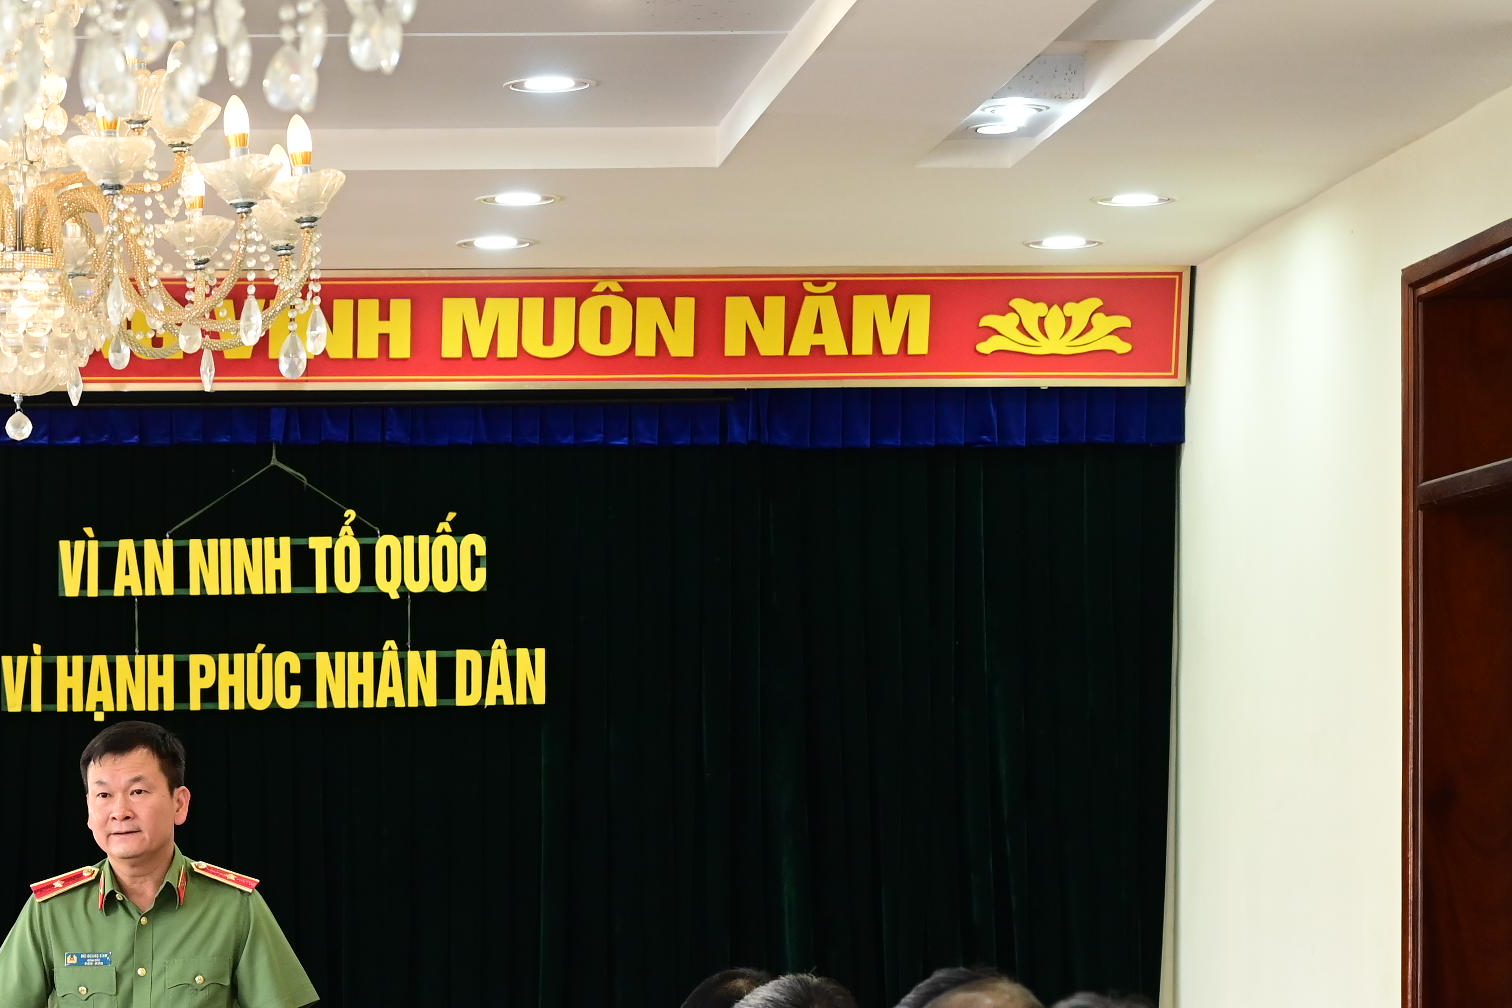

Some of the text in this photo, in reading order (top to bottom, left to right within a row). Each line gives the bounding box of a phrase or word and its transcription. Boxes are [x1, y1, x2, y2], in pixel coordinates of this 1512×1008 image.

[440, 280, 696, 358] MUÔN
[724, 280, 932, 357] NĂM
[58, 508, 487, 600] VÌ AN NINH TỔ QUỐC
[0, 637, 547, 722] VÌ HẠNH PHÚC NHÂN DÂN
